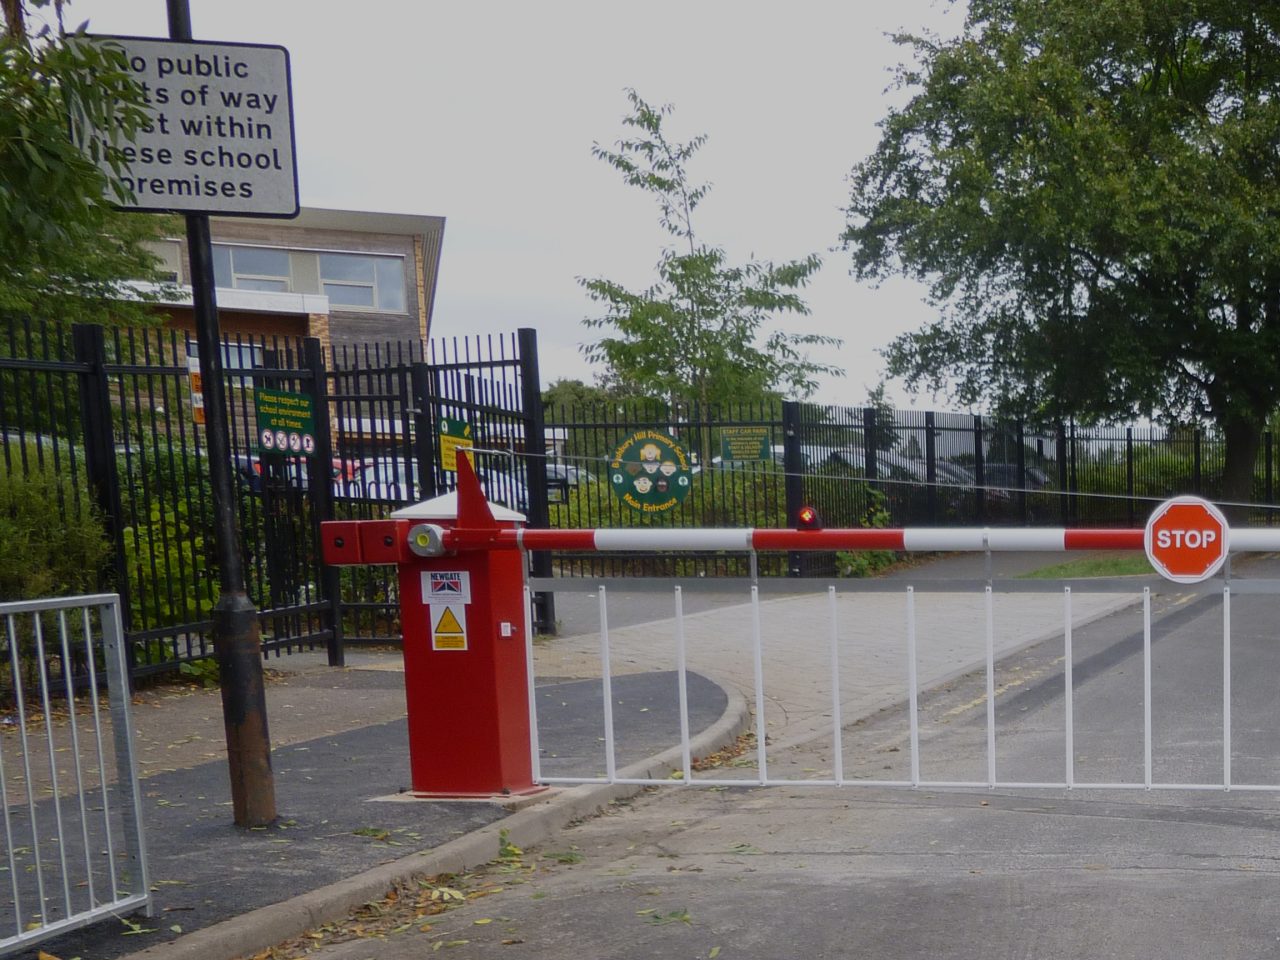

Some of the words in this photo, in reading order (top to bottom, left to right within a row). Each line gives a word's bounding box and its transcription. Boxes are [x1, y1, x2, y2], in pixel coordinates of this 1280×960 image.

[158, 54, 249, 79] public
[180, 84, 208, 105] of
[220, 91, 277, 114] way
[180, 116, 272, 140] within
[184, 146, 282, 170] school
[623, 492, 641, 509] Main
[1157, 529, 1216, 549] STOP
